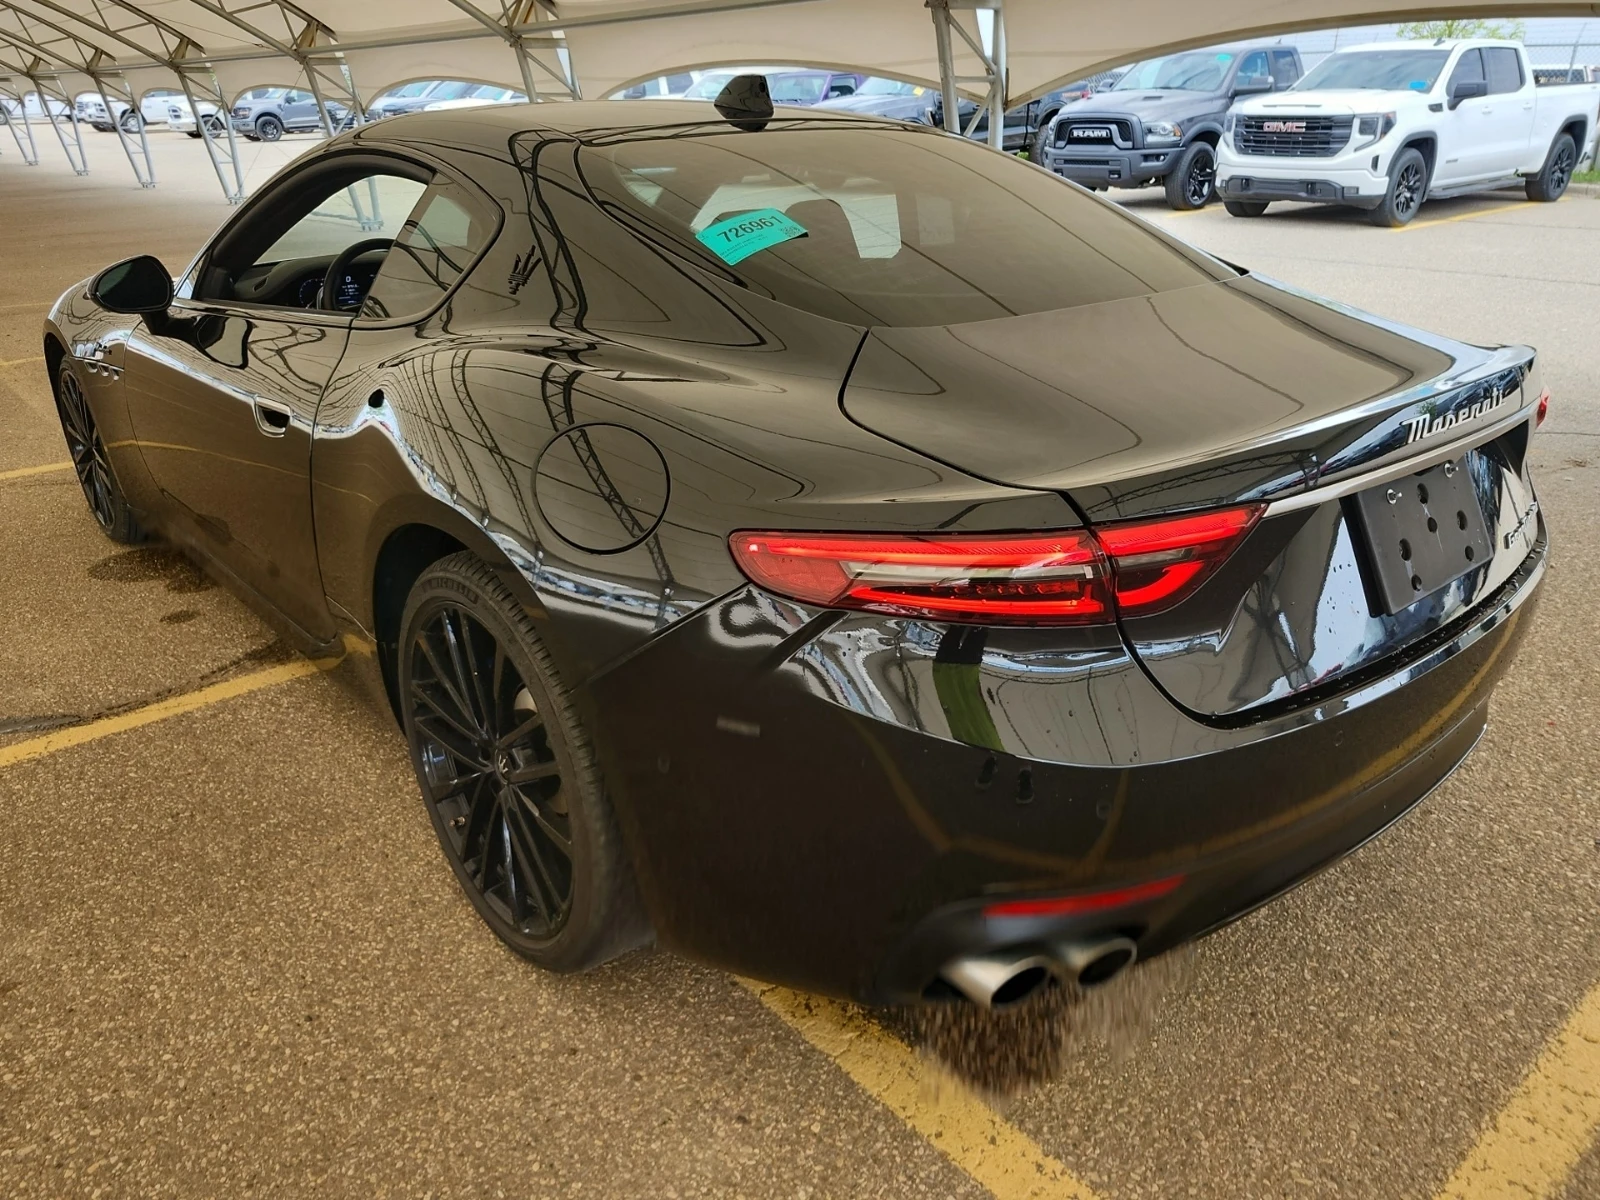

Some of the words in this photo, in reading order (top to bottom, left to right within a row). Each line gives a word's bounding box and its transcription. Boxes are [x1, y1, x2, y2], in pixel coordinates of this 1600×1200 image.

[1072, 129, 1109, 138] RAM
[1263, 121, 1306, 132] GMC
[717, 215, 783, 243] 726961
[1400, 388, 1506, 444] Maserati
